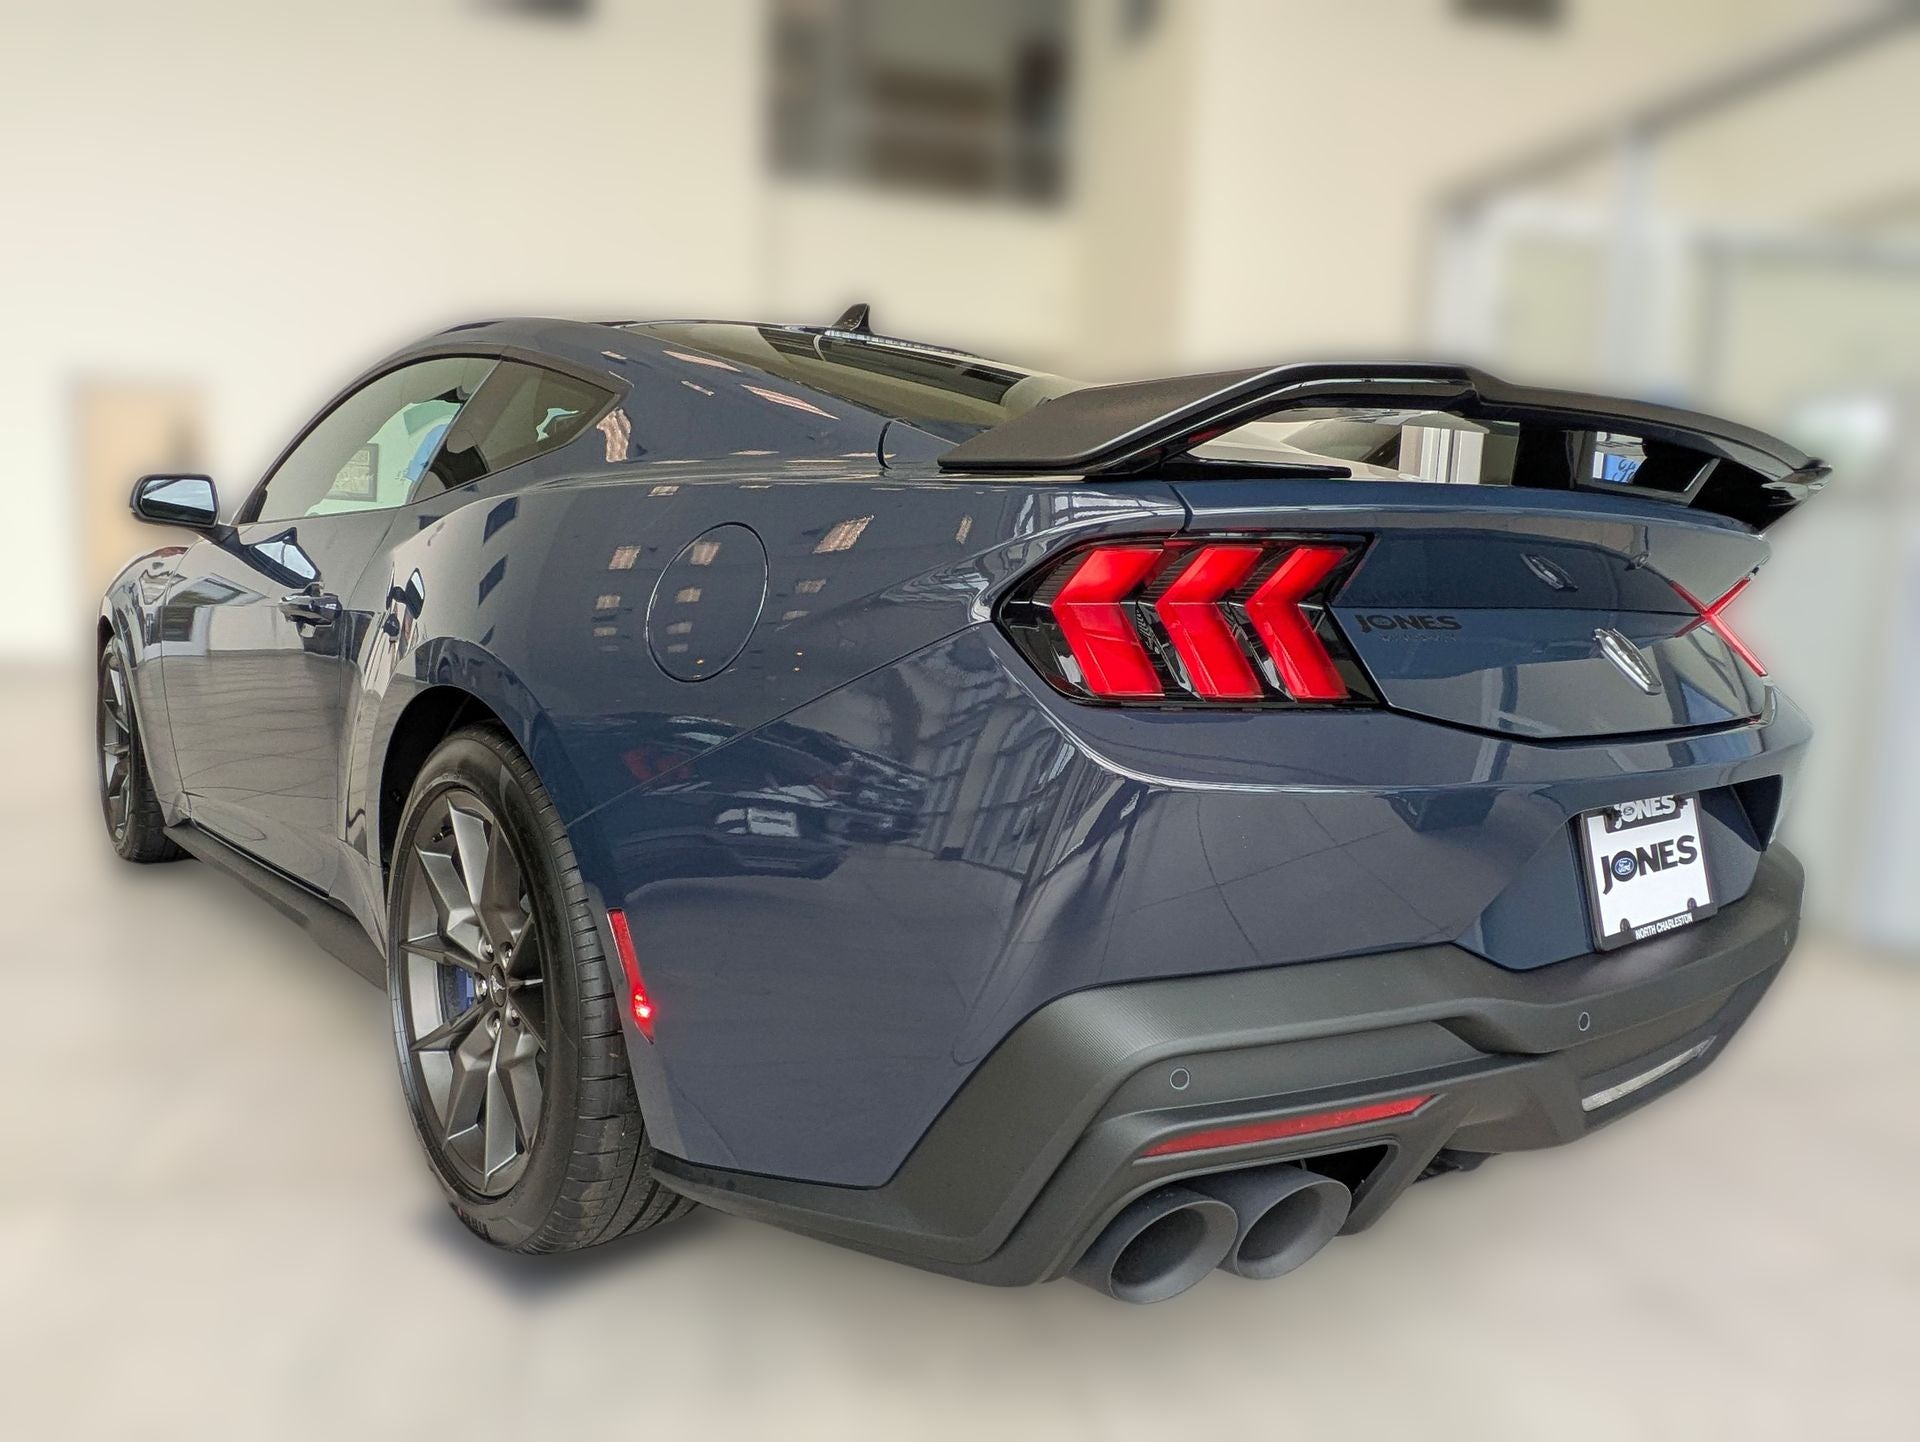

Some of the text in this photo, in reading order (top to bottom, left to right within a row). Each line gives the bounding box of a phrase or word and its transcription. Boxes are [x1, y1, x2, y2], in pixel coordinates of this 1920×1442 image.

[1354, 614, 1462, 633] JONES
[1614, 794, 1676, 830] JONES
[1600, 835, 1698, 895] JONES
[1635, 912, 1693, 940] NORTH CHARLESTON
